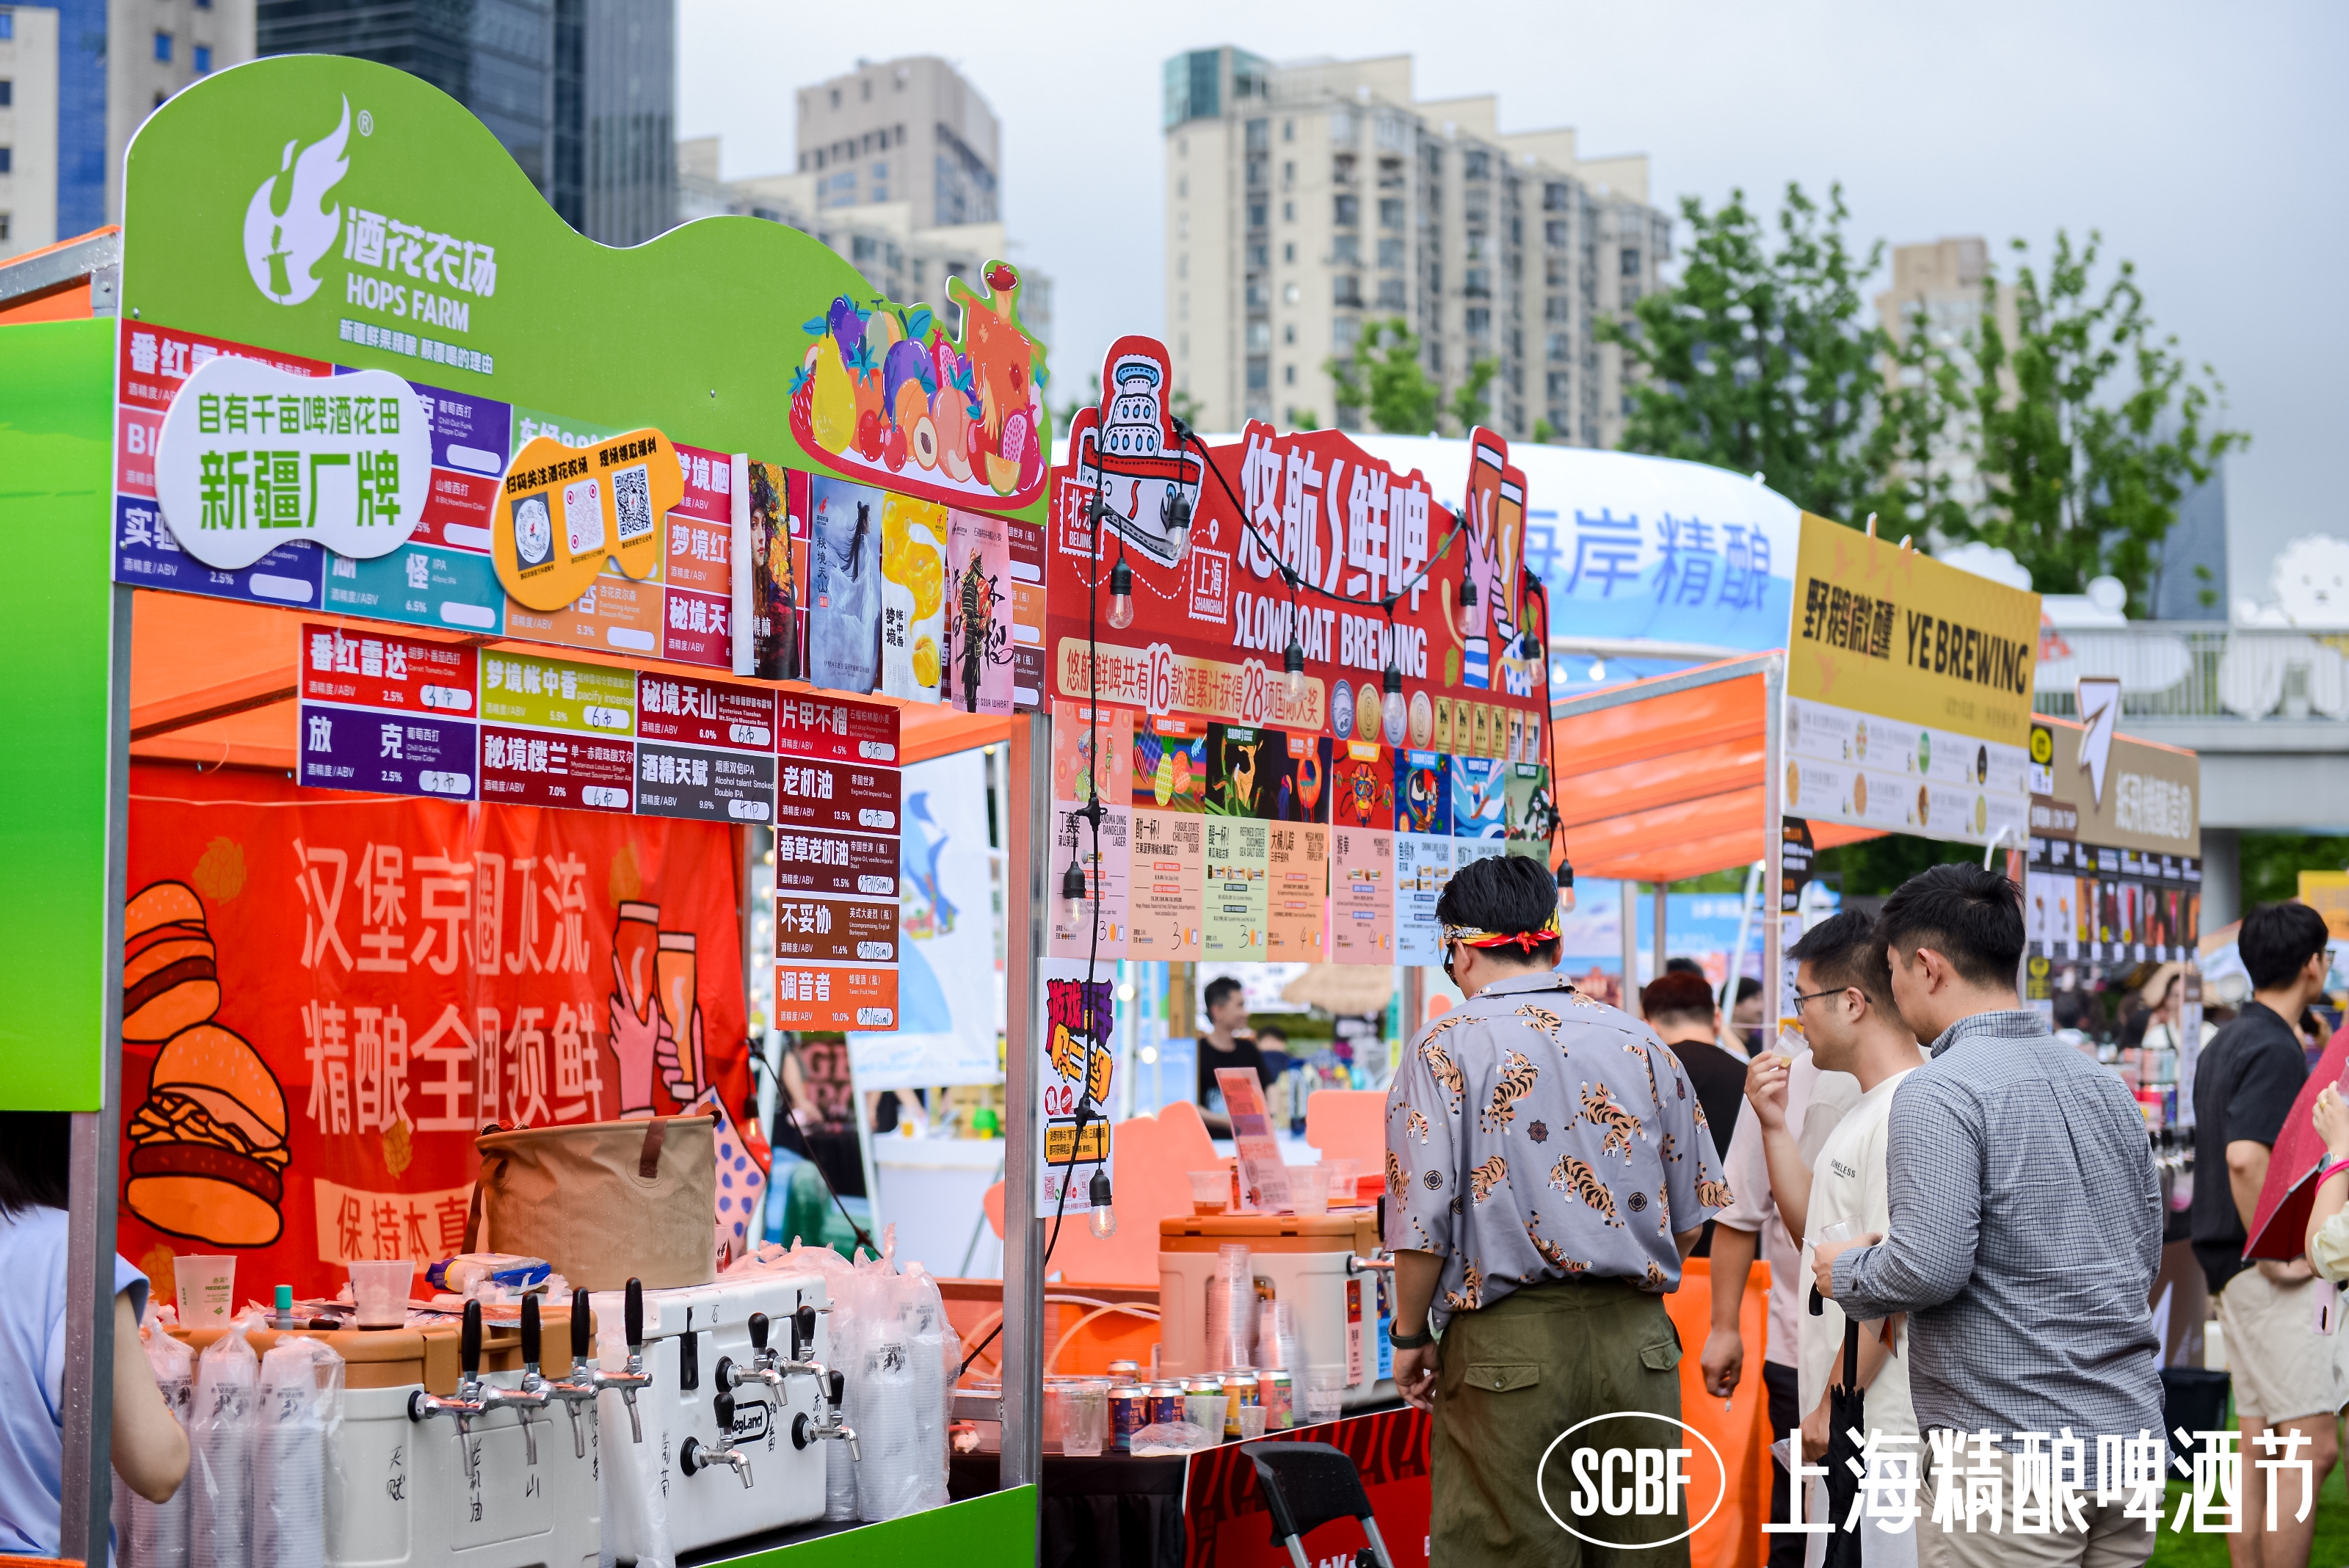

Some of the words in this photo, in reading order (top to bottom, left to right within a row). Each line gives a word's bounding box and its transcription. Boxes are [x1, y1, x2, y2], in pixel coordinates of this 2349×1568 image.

[343, 206, 498, 297] 酒花农场
[346, 272, 407, 316] HOPS
[413, 292, 469, 333] FARM
[339, 318, 418, 357] 新疆鲜果精酿
[421, 338, 494, 375] 颠覆喝的理由
[199, 393, 400, 435] 自有千亩啤酒花田
[438, 399, 472, 418] 葡萄西打
[506, 456, 589, 494] 扫码关注酒花农场
[599, 437, 657, 467] 现场领取福利
[200, 450, 400, 530] 新疆厂牌
[123, 557, 178, 576] 酒精度/ABV
[209, 571, 234, 584] 2.5%
[432, 559, 447, 570] IPA
[817, 537, 827, 594] 秘境天山
[670, 566, 707, 581] 酒精度/ABV
[1197, 556, 1223, 598] 上海
[331, 588, 379, 606] 酒精度/ABV
[405, 600, 426, 613] 6.5%
[600, 586, 636, 602] 杏花皮尔森
[1194, 597, 1222, 614] SHANGHAI
[511, 614, 553, 630] 酒精度/ABV
[576, 625, 595, 636] 5.3%
[669, 639, 705, 653] 酒精度/ABV
[1340, 612, 1428, 679] BREWING
[1907, 609, 1934, 669] YE
[1935, 620, 2029, 695] BREWING
[311, 633, 407, 680] 番红雷达
[407, 647, 460, 665] 胡萝卜番茄西打
[487, 659, 577, 700] 梦境帐中香
[308, 680, 355, 697] 酒精度/ABV
[382, 690, 404, 703] 2.5%
[577, 691, 602, 704] pacify
[604, 693, 634, 706] incense
[642, 679, 716, 720] 秘境天山
[485, 703, 526, 716] 酒精度/ABV
[550, 711, 568, 722] 5.5%
[719, 707, 742, 716] Mysterious
[743, 710, 761, 718] Tianshan
[739, 717, 756, 725] Moscato
[782, 699, 848, 736] 片甲不榴
[850, 709, 890, 725] 石榴柏林酸小麦
[407, 727, 440, 742] 葡萄西打
[642, 722, 678, 735] 酒精度/ABV
[700, 729, 716, 740] 6.0%
[484, 735, 568, 774] 秘境楼兰
[571, 744, 633, 763] 单一赤霞珠酸艾尔
[781, 738, 813, 750] 酒精度/ABV
[832, 746, 846, 755] 4.5%
[307, 763, 355, 777] 酒精度/ABV
[381, 771, 402, 783] 2.5%
[570, 769, 591, 777] Cabernet
[642, 753, 708, 787] 酒精天赋
[715, 760, 755, 775] 烟熏双倍IPA
[484, 780, 525, 793] 酒精度/ABV
[548, 786, 566, 797] 7.0%
[715, 777, 735, 785] Alcohol
[736, 780, 752, 788] talent
[753, 781, 774, 790] Smoked
[783, 766, 833, 799] 老机油
[852, 774, 874, 788] 帝国世涛
[641, 794, 677, 807] 酒精度/ABV
[700, 800, 714, 810] 9.8%
[714, 788, 734, 797] Double
[735, 790, 744, 799] IPA
[783, 805, 815, 817] 酒精度/ABV
[834, 810, 851, 821] 13.5%
[1103, 826, 1126, 835] DANDELION
[1174, 821, 1187, 832] FUGUE
[1188, 823, 1199, 832] STATE
[1240, 827, 1253, 838] REFINED
[1254, 827, 1266, 838] STATE
[1113, 836, 1126, 847] LAGER
[1172, 832, 1183, 841] CHILI
[1184, 832, 1199, 843] FRUITED
[1246, 838, 1265, 849] CUCUMBER
[1305, 832, 1314, 841] MEGA
[1315, 832, 1324, 842] MOON
[781, 835, 849, 865] 香草老机油
[1136, 843, 1178, 856] 芒果菠萝辣椒水果酸艾尔
[1188, 843, 1199, 854] SOUR
[1247, 847, 1255, 857] SALT
[1256, 847, 1265, 858] GOSE
[1307, 852, 1318, 860] TRIPLE
[781, 874, 813, 885] 酒精度/ABV
[833, 878, 849, 888] 13.5%
[293, 838, 591, 978] 汉堡京圈顶流
[781, 903, 832, 934] 不妥协
[781, 943, 813, 953] 酒精度/ABV
[832, 945, 848, 955] 11.6%
[781, 970, 830, 1001] 调音者
[780, 1011, 813, 1022] 酒精度/ABV
[832, 1012, 849, 1022] 10.0%
[301, 998, 604, 1137] 精酿全国领鲜
[733, 1412, 763, 1435] egLand
